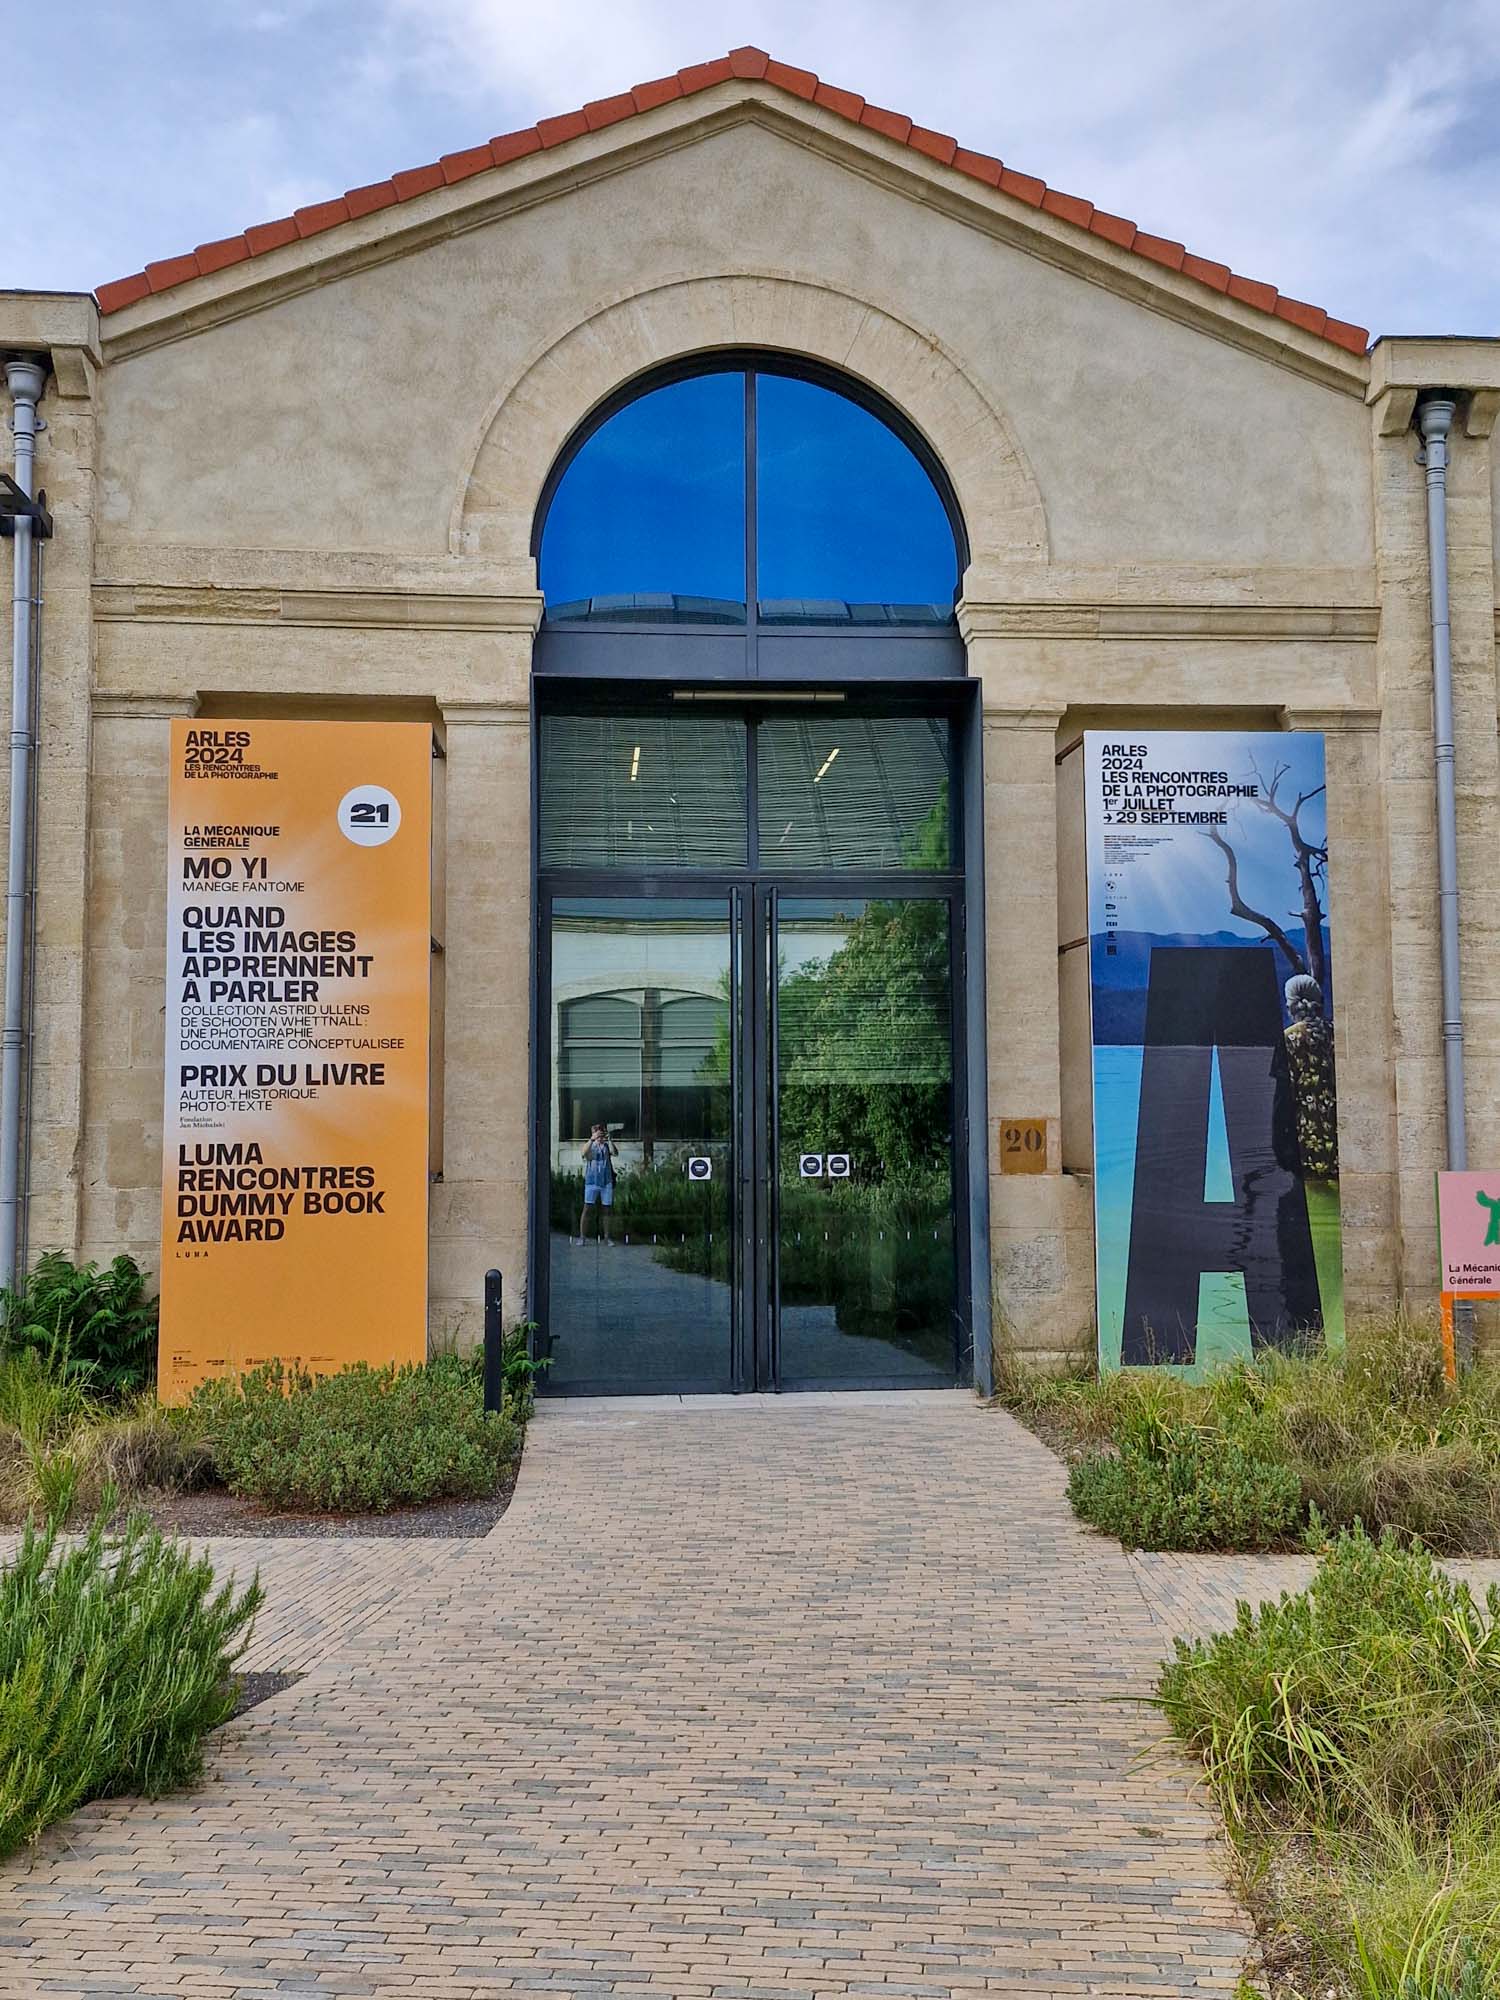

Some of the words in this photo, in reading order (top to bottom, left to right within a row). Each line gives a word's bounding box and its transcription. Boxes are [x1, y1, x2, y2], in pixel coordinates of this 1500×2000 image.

[185, 731, 251, 747] ARLES
[185, 748, 244, 764] 2024
[1102, 745, 1148, 757] ARLES
[203, 764, 261, 772] RENCONTRES
[1102, 758, 1143, 770] 2024
[211, 772, 279, 780] PHOTOGRAPHIE
[1102, 771, 1128, 783] LES
[1132, 772, 1228, 784] RENCONTRES
[1102, 785, 1121, 797] DE
[1124, 785, 1143, 797] LA
[1146, 785, 1259, 797] PHOTOGRAPHIE
[1102, 798, 1119, 810] 1er
[1122, 798, 1175, 810] JUILLET
[350, 803, 389, 823] 21
[1116, 811, 1137, 824] 29
[1141, 811, 1228, 824] SEPTEMBRE
[184, 826, 200, 836] LA
[183, 857, 232, 879] MO
[241, 857, 267, 879] YI
[182, 906, 285, 929] QUAND
[182, 931, 235, 953] LES
[244, 931, 356, 953] IMAGES
[181, 955, 374, 978] APPRENNENT
[181, 979, 200, 1003] À
[210, 981, 319, 1003] PARLER
[181, 1005, 266, 1016] COLLECTION
[269, 1004, 317, 1015] ASTRID
[320, 1004, 370, 1015] ULLENS
[181, 1017, 198, 1027] DE
[201, 1016, 277, 1027] SCHOOTEN
[281, 1015, 363, 1027] WHETTNALL
[181, 1028, 206, 1039] UNE
[210, 1027, 313, 1039] PHOTOGRAPHIE
[180, 1039, 284, 1050] DOCUMENTAIRE
[180, 1064, 248, 1087] PRIX
[256, 1064, 297, 1086] DU
[305, 1064, 385, 1086] LIVRE
[179, 1100, 273, 1112] PHOTO-TEXTE
[1005, 1128, 1042, 1152] 20
[178, 1143, 263, 1167] LUMA
[178, 1167, 375, 1192] RENCONTRES
[177, 1193, 295, 1217] DUMMY
[303, 1191, 386, 1214] BOOK
[176, 1219, 285, 1242] AWARD
[1449, 1264, 1460, 1273] La
[1449, 1276, 1492, 1285] Générale
